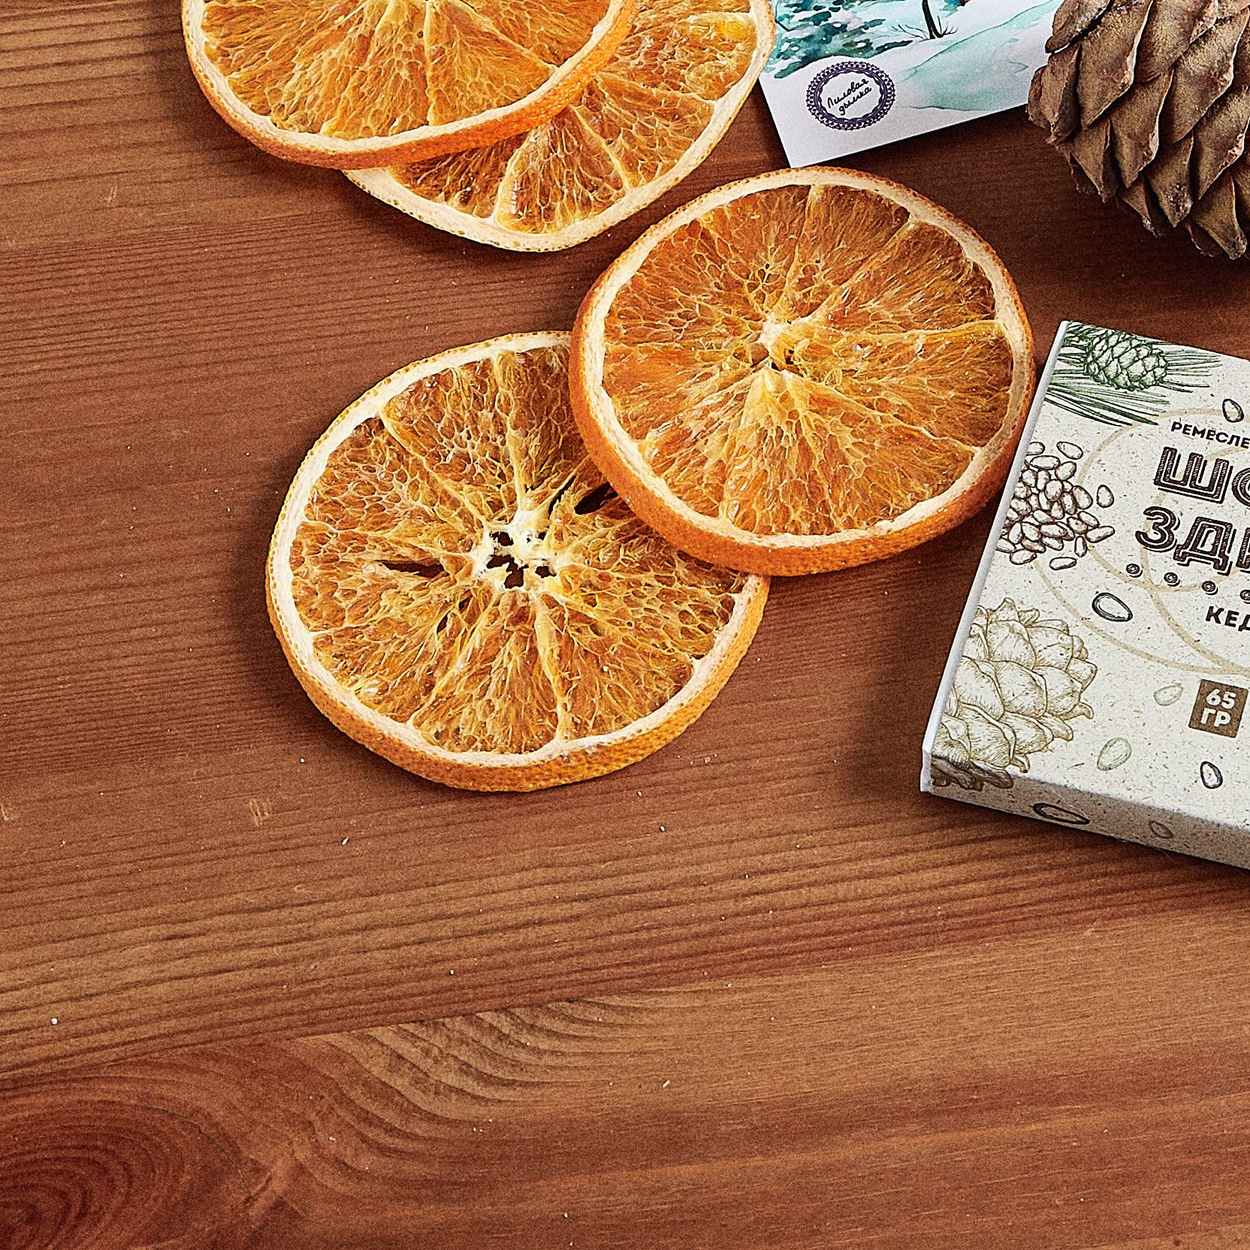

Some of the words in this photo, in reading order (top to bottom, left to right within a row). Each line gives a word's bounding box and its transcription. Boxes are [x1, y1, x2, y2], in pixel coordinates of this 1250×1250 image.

[827, 78, 870, 108] Лиловая
[838, 86, 872, 116] дымка
[1205, 688, 1237, 710] 65
[1199, 707, 1232, 729] ГР
